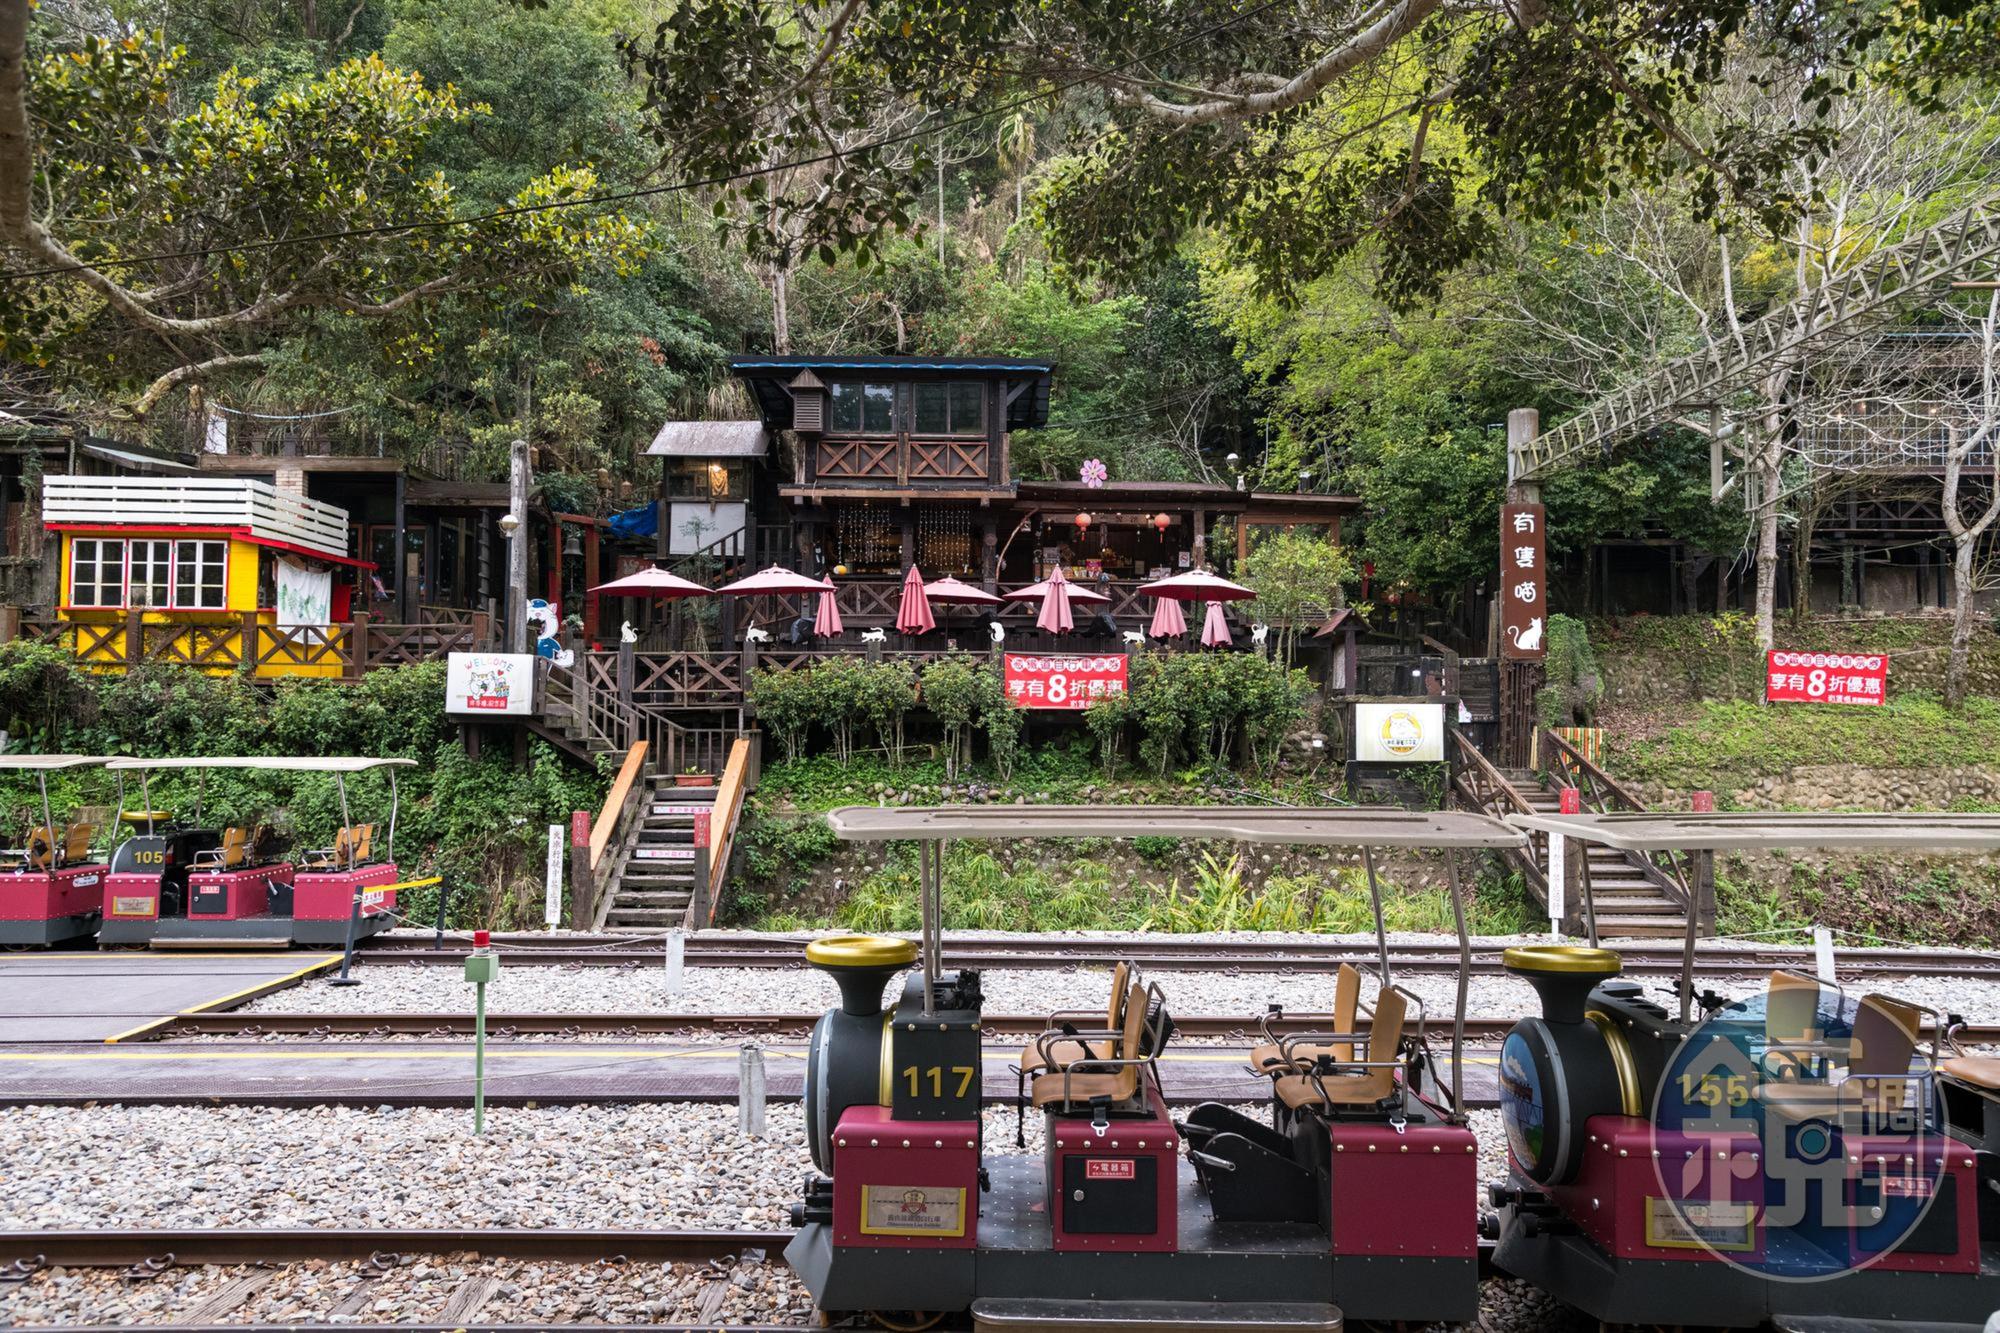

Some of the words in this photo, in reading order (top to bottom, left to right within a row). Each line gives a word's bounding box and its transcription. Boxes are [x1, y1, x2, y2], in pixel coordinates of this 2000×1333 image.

[1513, 511, 1536, 603] 有隻喵
[464, 657, 514, 673] WELCOME
[1769, 669, 1882, 697] 享有8折優惠
[134, 851, 164, 864] 105
[903, 1066, 974, 1098] 117
[1675, 1074, 1749, 1107] 155
